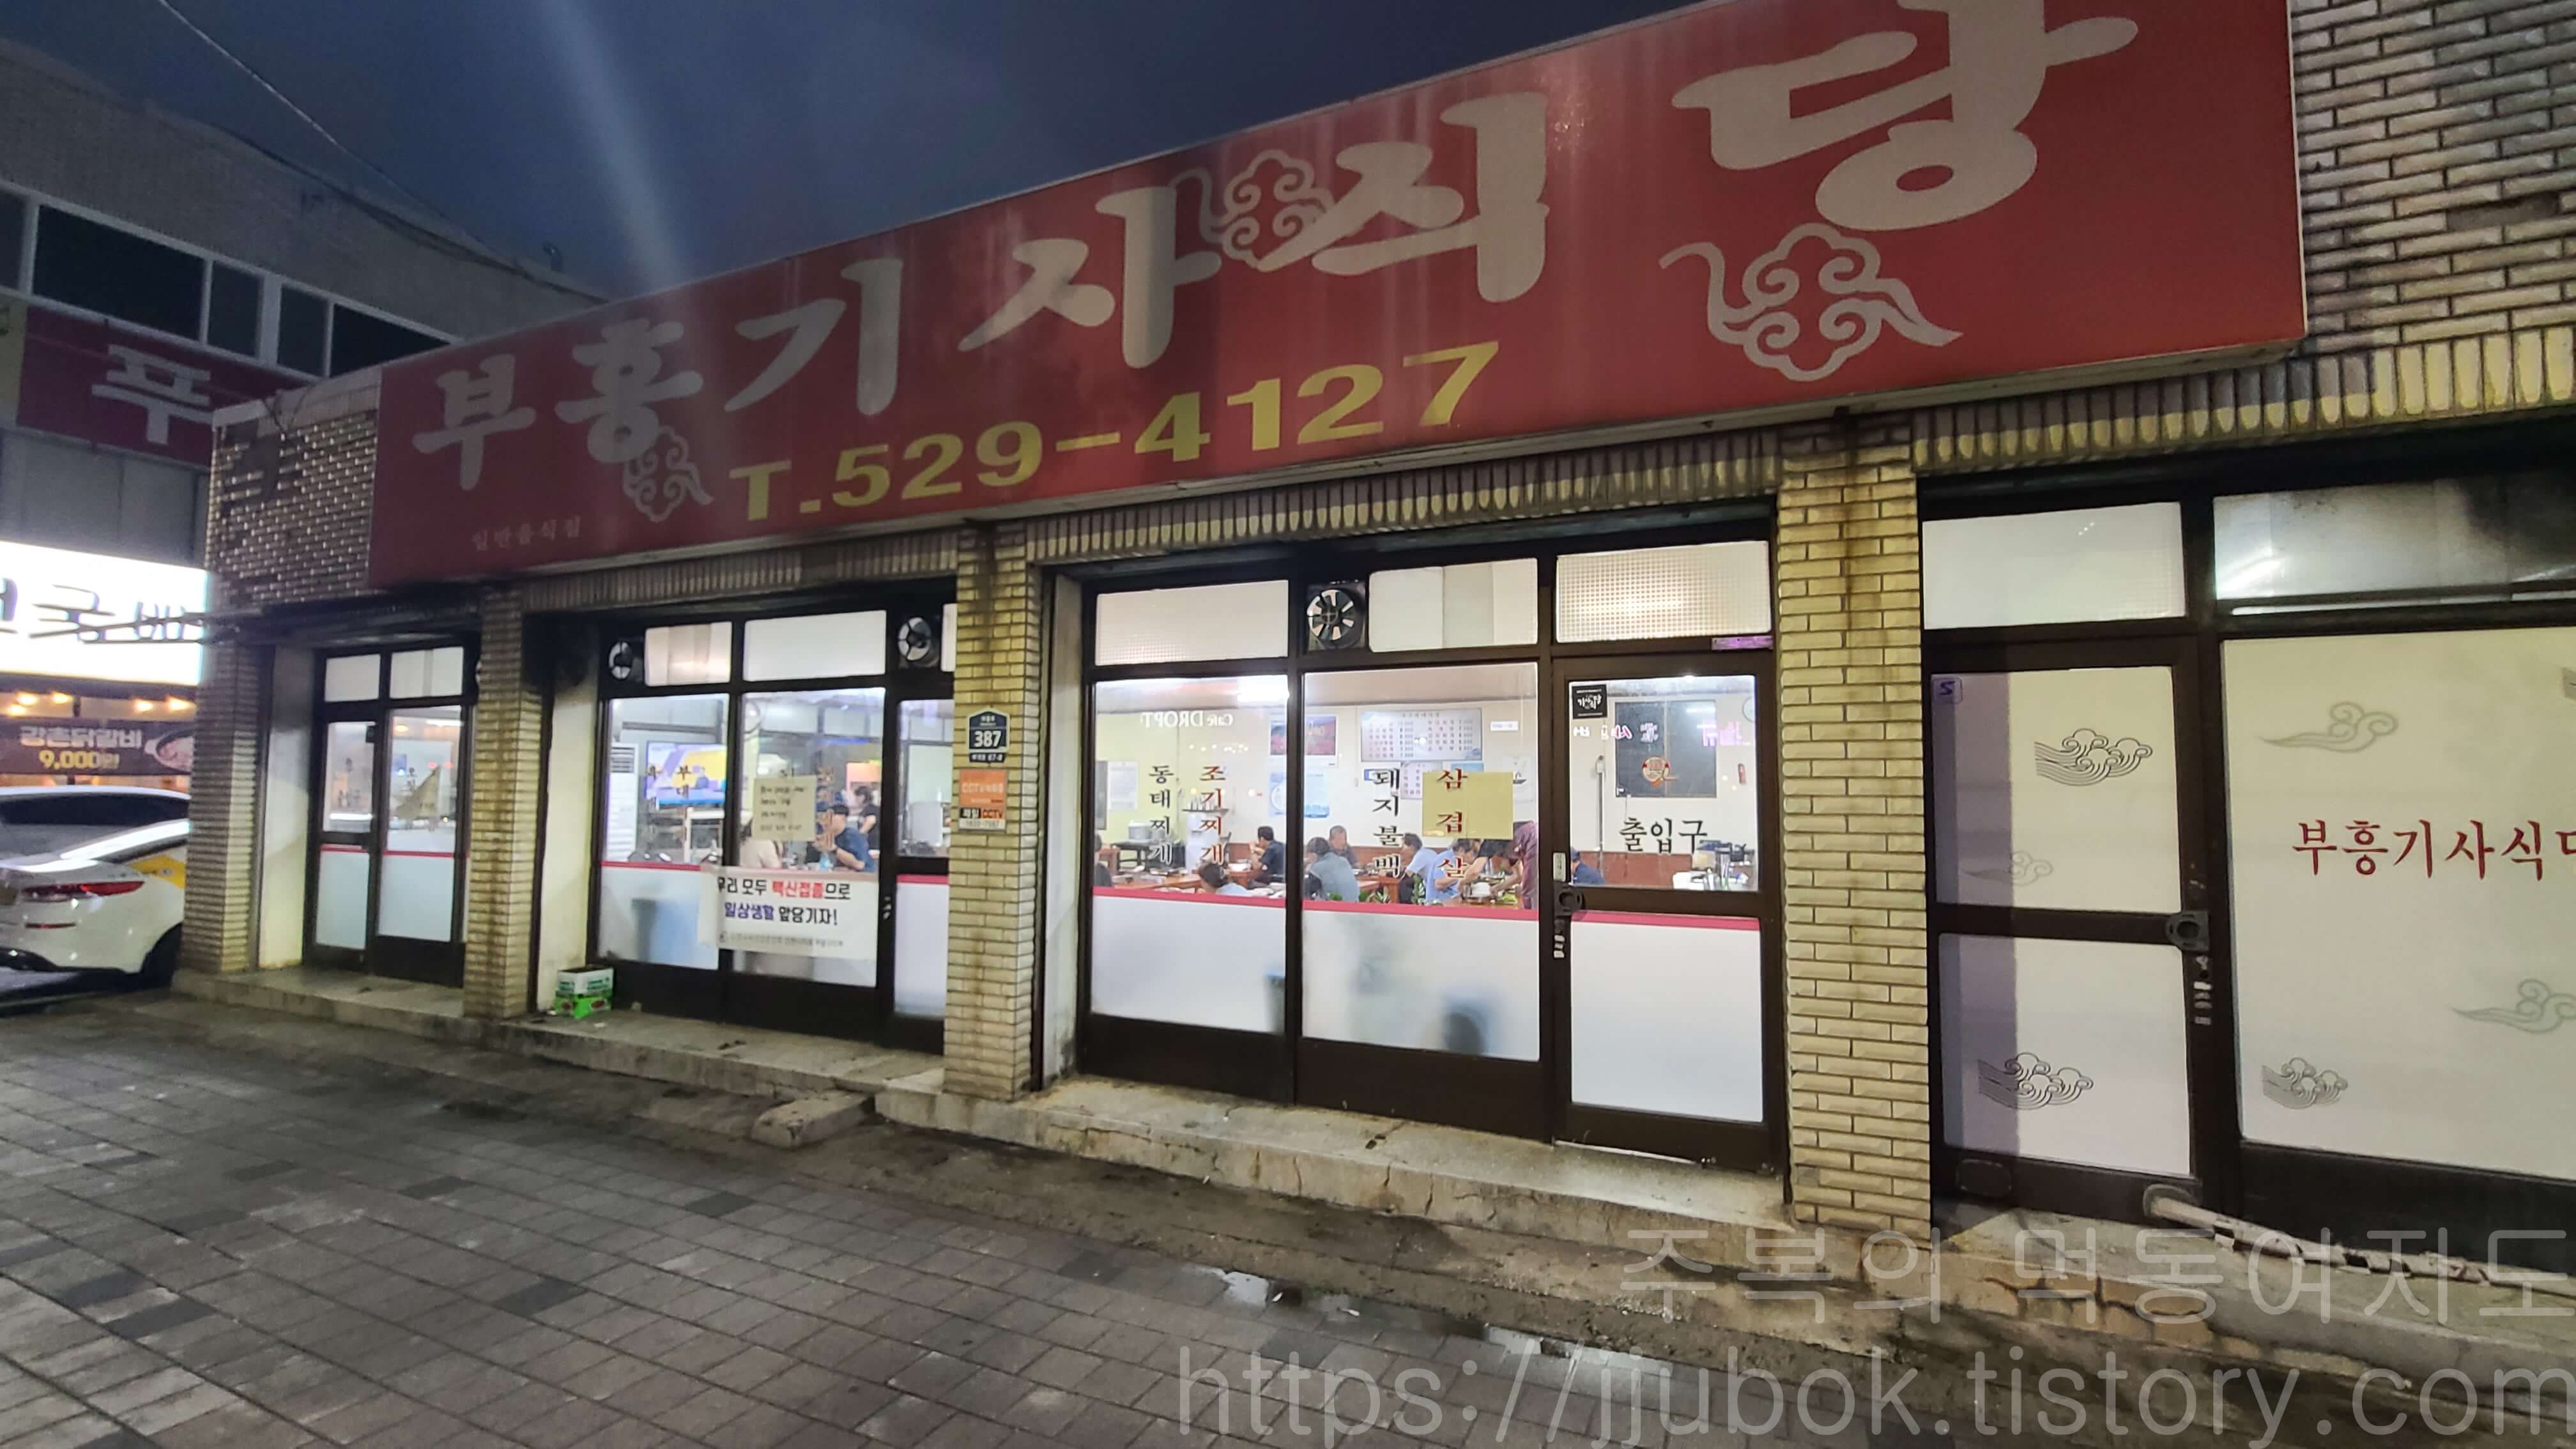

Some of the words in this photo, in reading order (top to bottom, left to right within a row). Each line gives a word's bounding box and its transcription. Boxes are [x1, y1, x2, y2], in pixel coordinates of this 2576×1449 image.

[413, 0, 2138, 491] 부흥기사식당
[728, 342, 1499, 522] T.529-4127
[974, 730, 1002, 747] 387
[1148, 765, 1174, 865] 동태찌개
[1199, 765, 1226, 866] 조기찌개
[1372, 767, 1404, 878] 돼지불백
[1436, 767, 1468, 879] 삼겹살
[1618, 816, 1708, 854] 출입구
[717, 876, 738, 893] 우리
[742, 878, 767, 895] 모두
[724, 902, 774, 921] 일상생활
